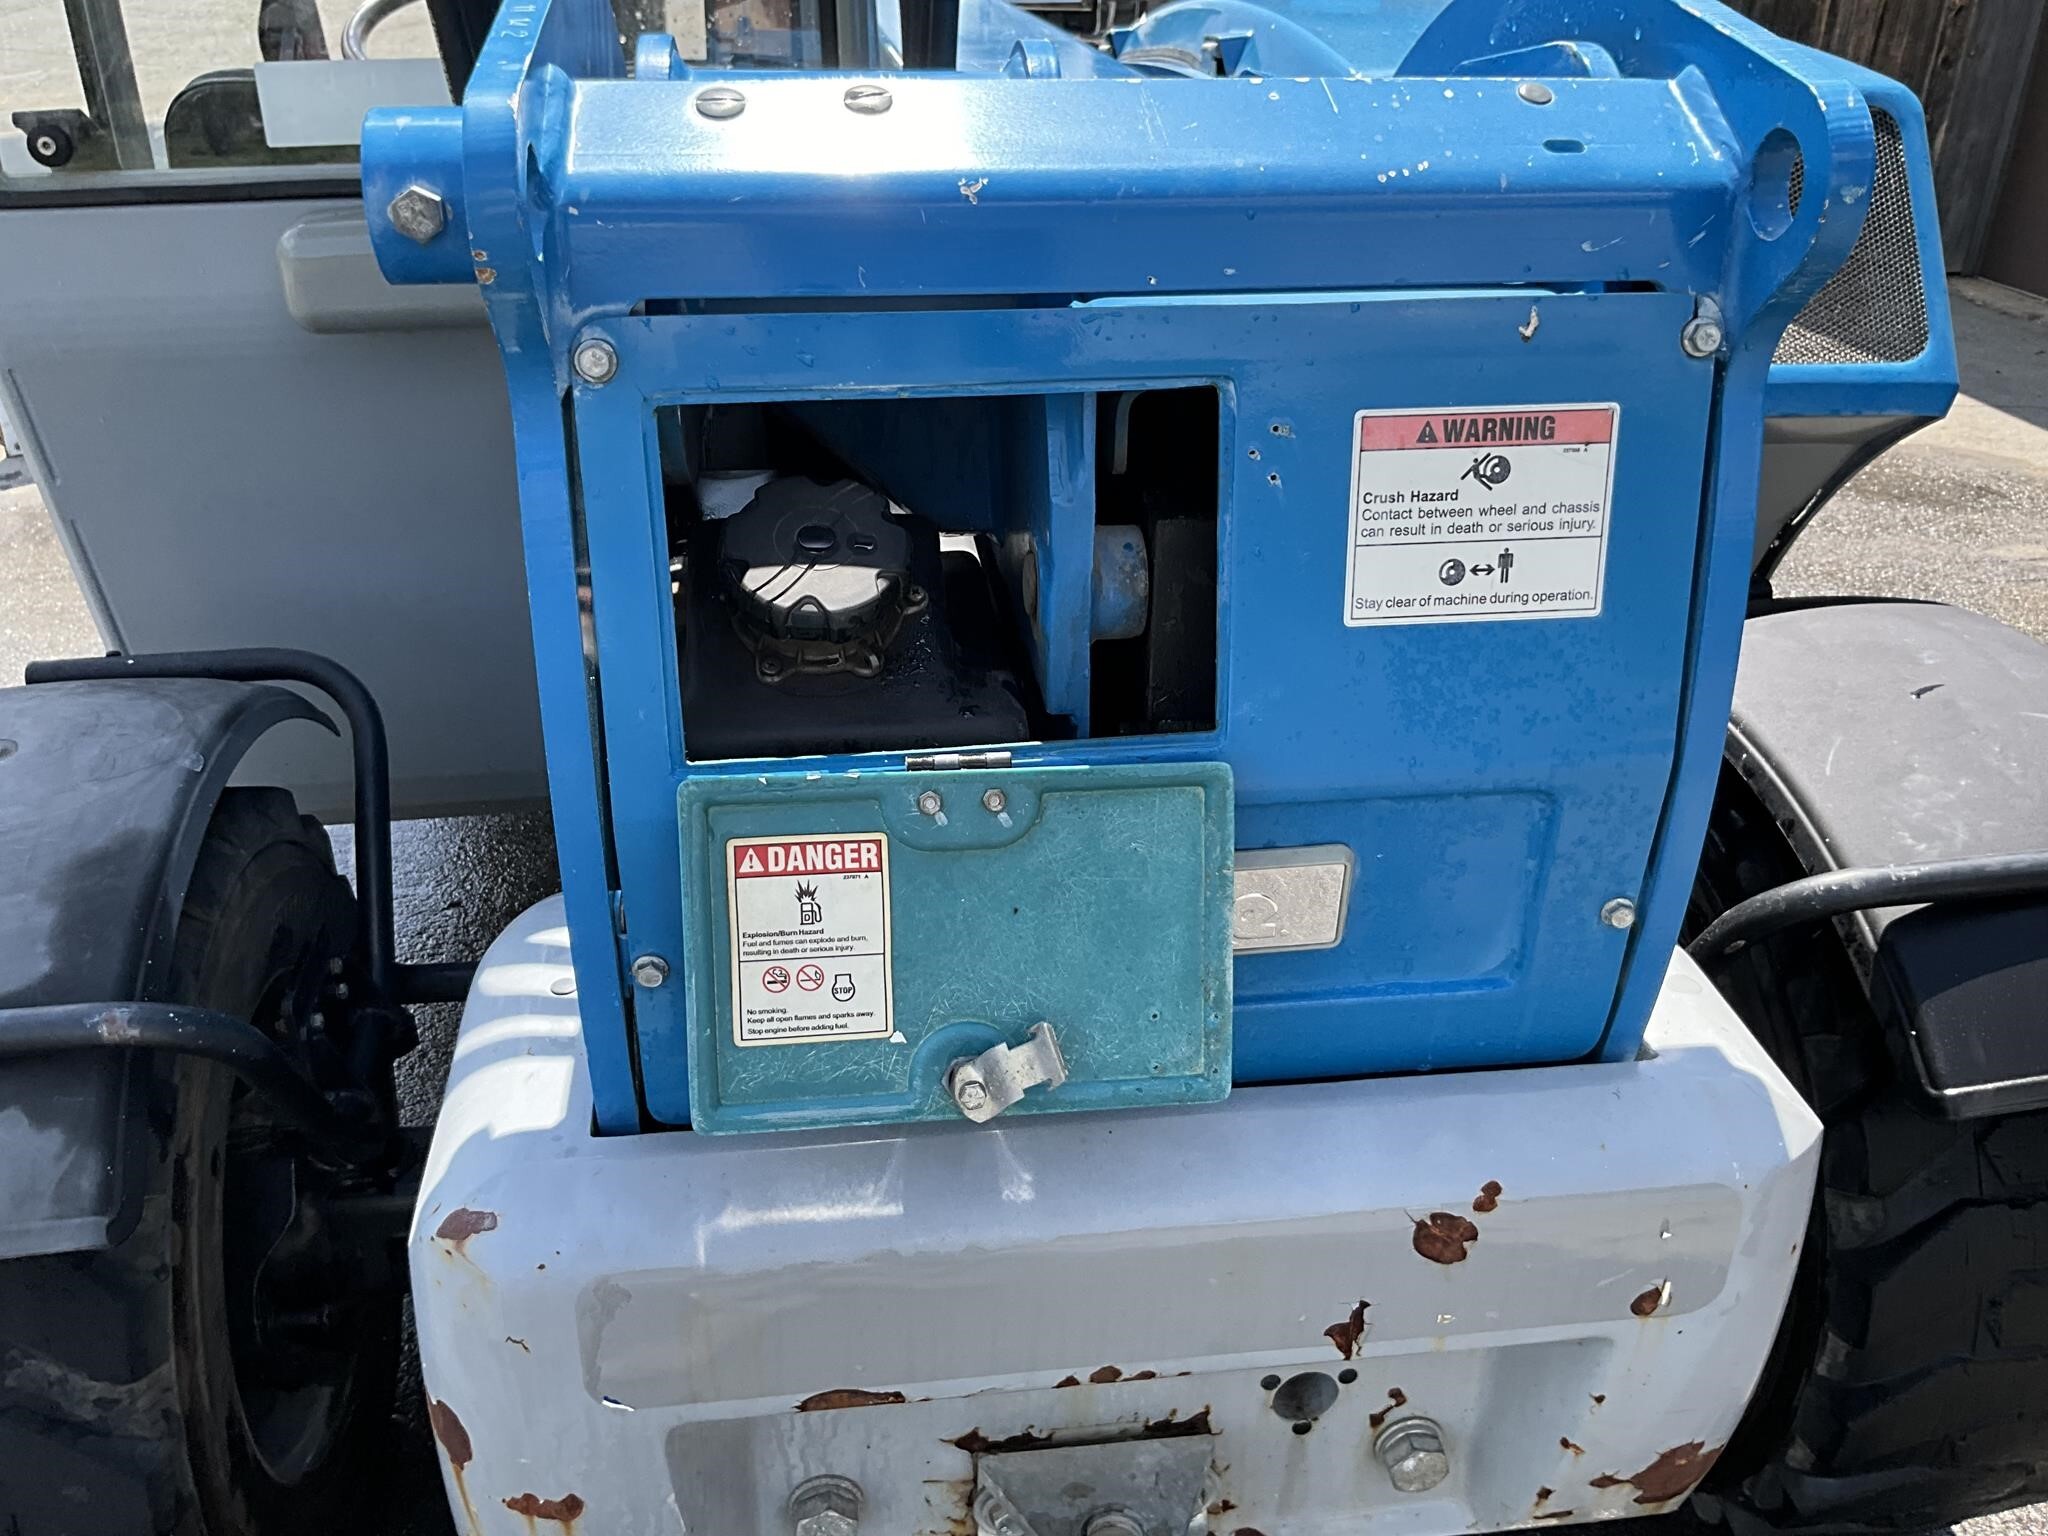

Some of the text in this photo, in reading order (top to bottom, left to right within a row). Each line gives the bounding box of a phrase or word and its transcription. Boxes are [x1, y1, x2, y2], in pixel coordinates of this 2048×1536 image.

[1443, 416, 1555, 442] WARNING
[1363, 489, 1459, 504] Crush Hazard
[1362, 500, 1600, 521] Contact between wheel and chassis
[1360, 518, 1596, 538] can result in death or serious injury.
[1355, 588, 1594, 612] Stay clear of machine during operation.
[768, 842, 879, 872] DANGER
[742, 928, 824, 940] Explosion/Burn Hazard
[809, 936, 836, 944] explode
[742, 948, 772, 957] resulting
[834, 987, 853, 995] STOP
[776, 1016, 793, 1024] open
[748, 1028, 764, 1036] Stop
[764, 1026, 788, 1034] engine
[811, 1024, 834, 1032] adding
